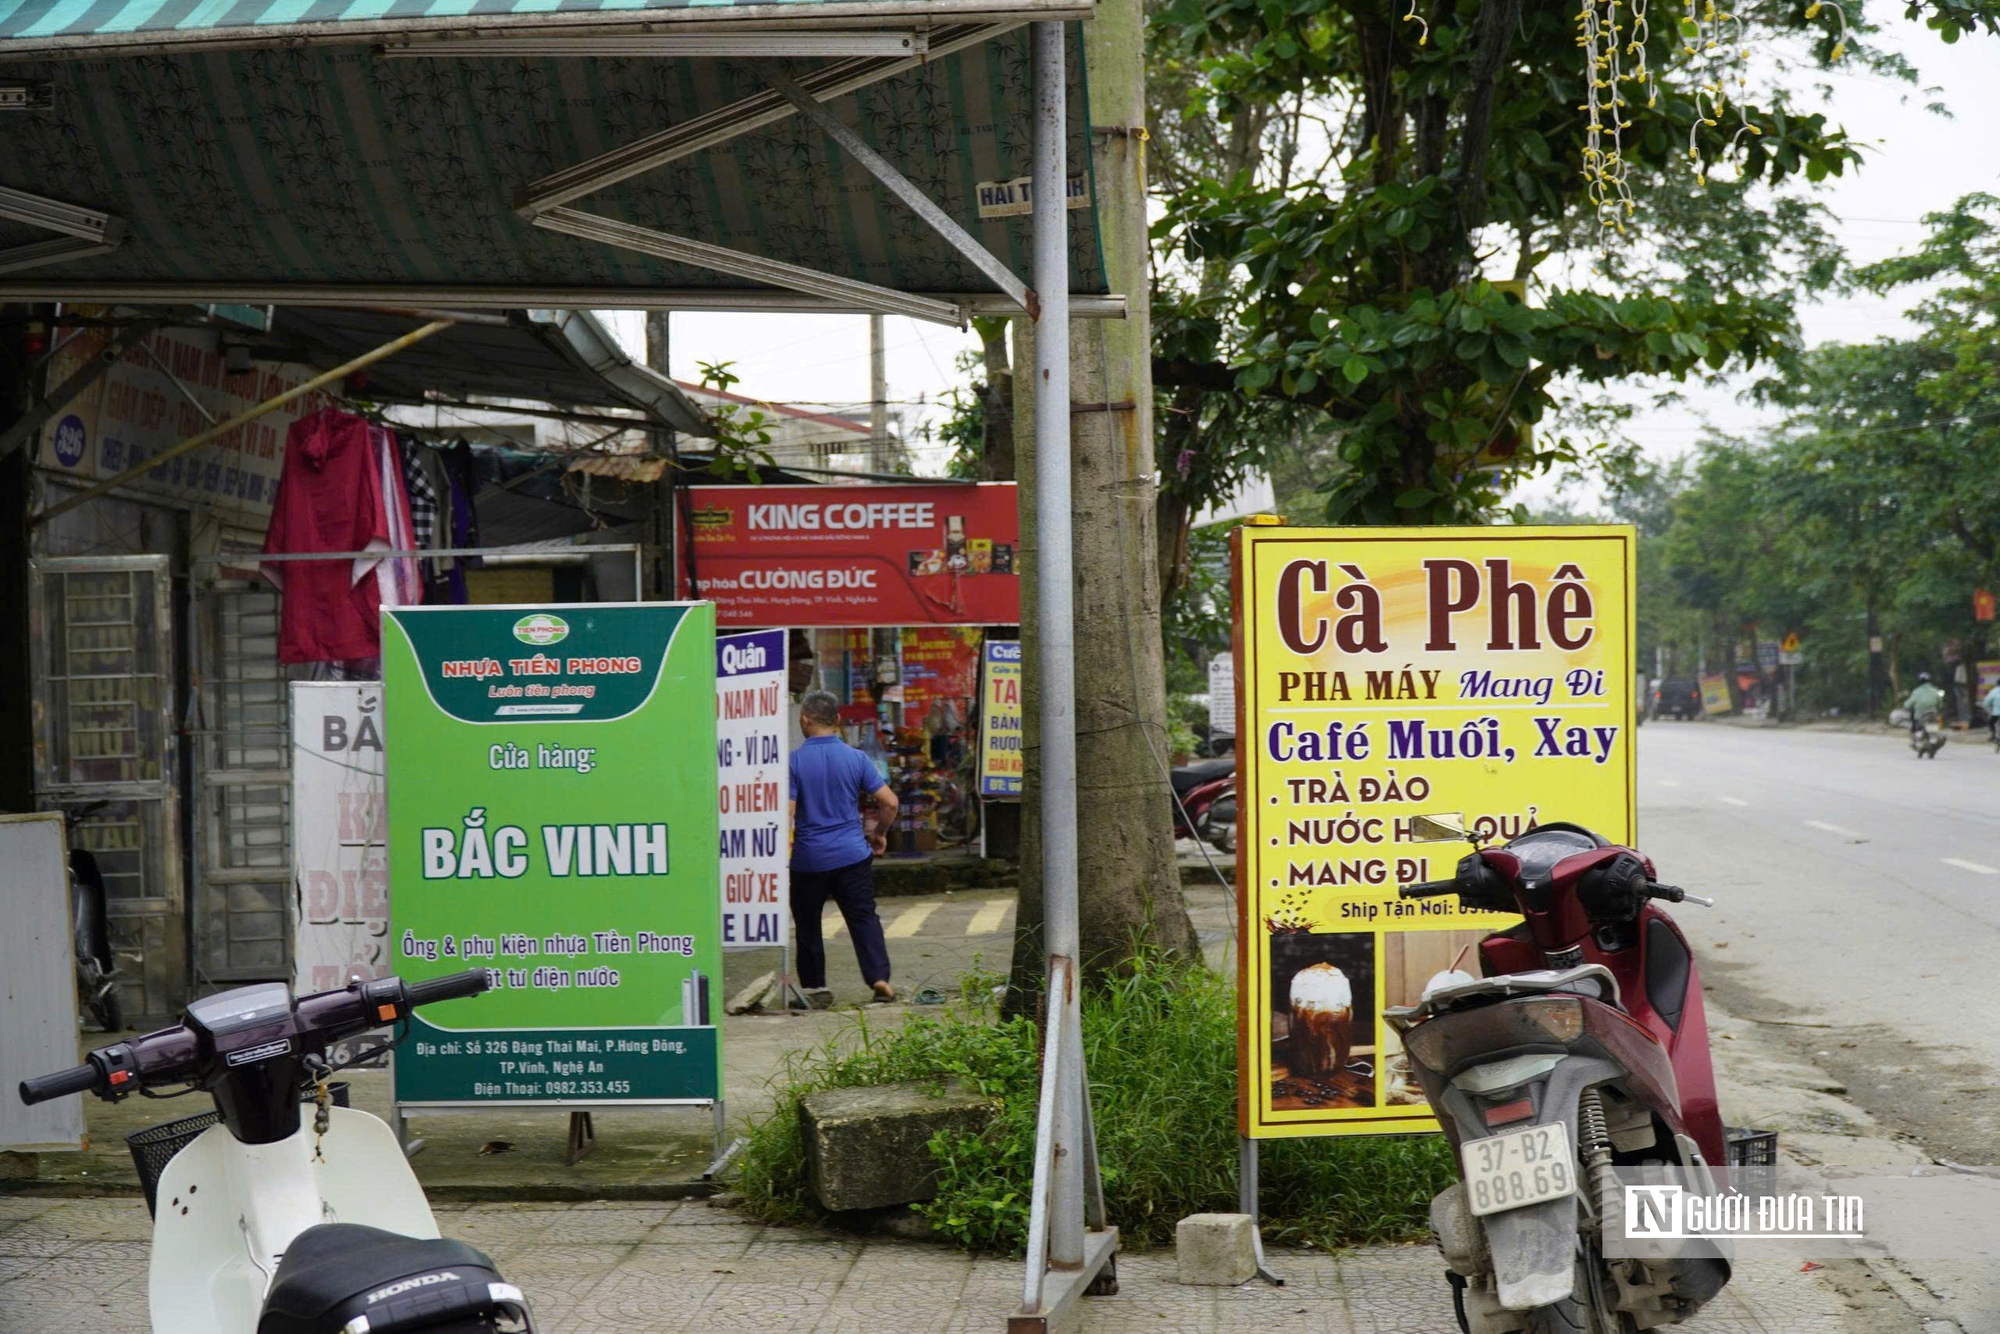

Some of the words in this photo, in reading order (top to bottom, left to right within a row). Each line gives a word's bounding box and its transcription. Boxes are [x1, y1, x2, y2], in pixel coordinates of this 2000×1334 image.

[981, 186, 1013, 206] HAI
[57, 425, 83, 458] 326
[748, 504, 820, 530] KING
[824, 503, 936, 529] COFFEE
[739, 567, 825, 589] CƯỜNG
[827, 567, 877, 589] ĐỨC
[1277, 558, 1389, 654] Cà
[1422, 558, 1594, 652] Phê
[442, 657, 503, 681] NHỰA
[510, 653, 560, 676] TIỀN
[567, 656, 641, 674] PHONG
[551, 684, 595, 698] phong
[1278, 671, 1352, 702] PHA
[1365, 663, 1441, 700] MÁY
[1459, 669, 1554, 705] Mang
[1564, 668, 1608, 698] Đi
[724, 689, 754, 720] NAM
[760, 681, 779, 716] NỮ
[745, 730, 758, 765] VÍ
[762, 735, 779, 764] DA
[1268, 720, 1371, 763] Café
[1387, 716, 1516, 765] Muối,
[1533, 717, 1619, 764] Xay
[489, 742, 530, 770] Cửa
[538, 744, 597, 773] hàng:
[736, 771, 778, 813] HIỂM
[1287, 770, 1351, 804] TRÀ
[1358, 770, 1430, 803] ĐÀO
[422, 807, 528, 879] BẮC
[542, 823, 669, 878] VINH
[752, 822, 778, 857] NỮ
[1288, 811, 1384, 845] NƯỚC
[726, 868, 754, 903] GIỮ
[758, 873, 778, 902] XE
[1288, 858, 1387, 887] MANG
[1395, 858, 1428, 884] ĐI
[744, 913, 778, 942] LAI
[1341, 902, 1378, 922] Ship
[1384, 901, 1415, 919] Tận
[402, 930, 438, 960] Ống
[444, 936, 456, 956] &
[463, 936, 494, 960] phụ
[501, 933, 538, 958] kiện
[544, 933, 586, 958] nhựa
[593, 929, 631, 953] Tiền
[637, 932, 694, 956] Phong
[507, 969, 527, 989] tư
[532, 967, 570, 992] điện
[576, 965, 619, 988] nước
[416, 1042, 436, 1058] Địa
[465, 1040, 482, 1055] Số
[485, 1041, 508, 1054] 326
[512, 1041, 543, 1057] Đặng
[546, 1040, 572, 1053] Thai
[576, 1040, 602, 1055] Mai,
[606, 1039, 649, 1055] P.Hưng
[500, 1061, 549, 1076] TP.Vinh,
[552, 1060, 584, 1077] Nghệ
[588, 1061, 603, 1073] An
[474, 1081, 501, 1097] Điện
[505, 1081, 542, 1097] Thoại:
[545, 1080, 631, 1094] 0982.353.455
[1477, 1130, 1553, 1173] 37-B2
[1475, 1162, 1567, 1209] 888.69
[366, 1272, 461, 1304] HONDA
